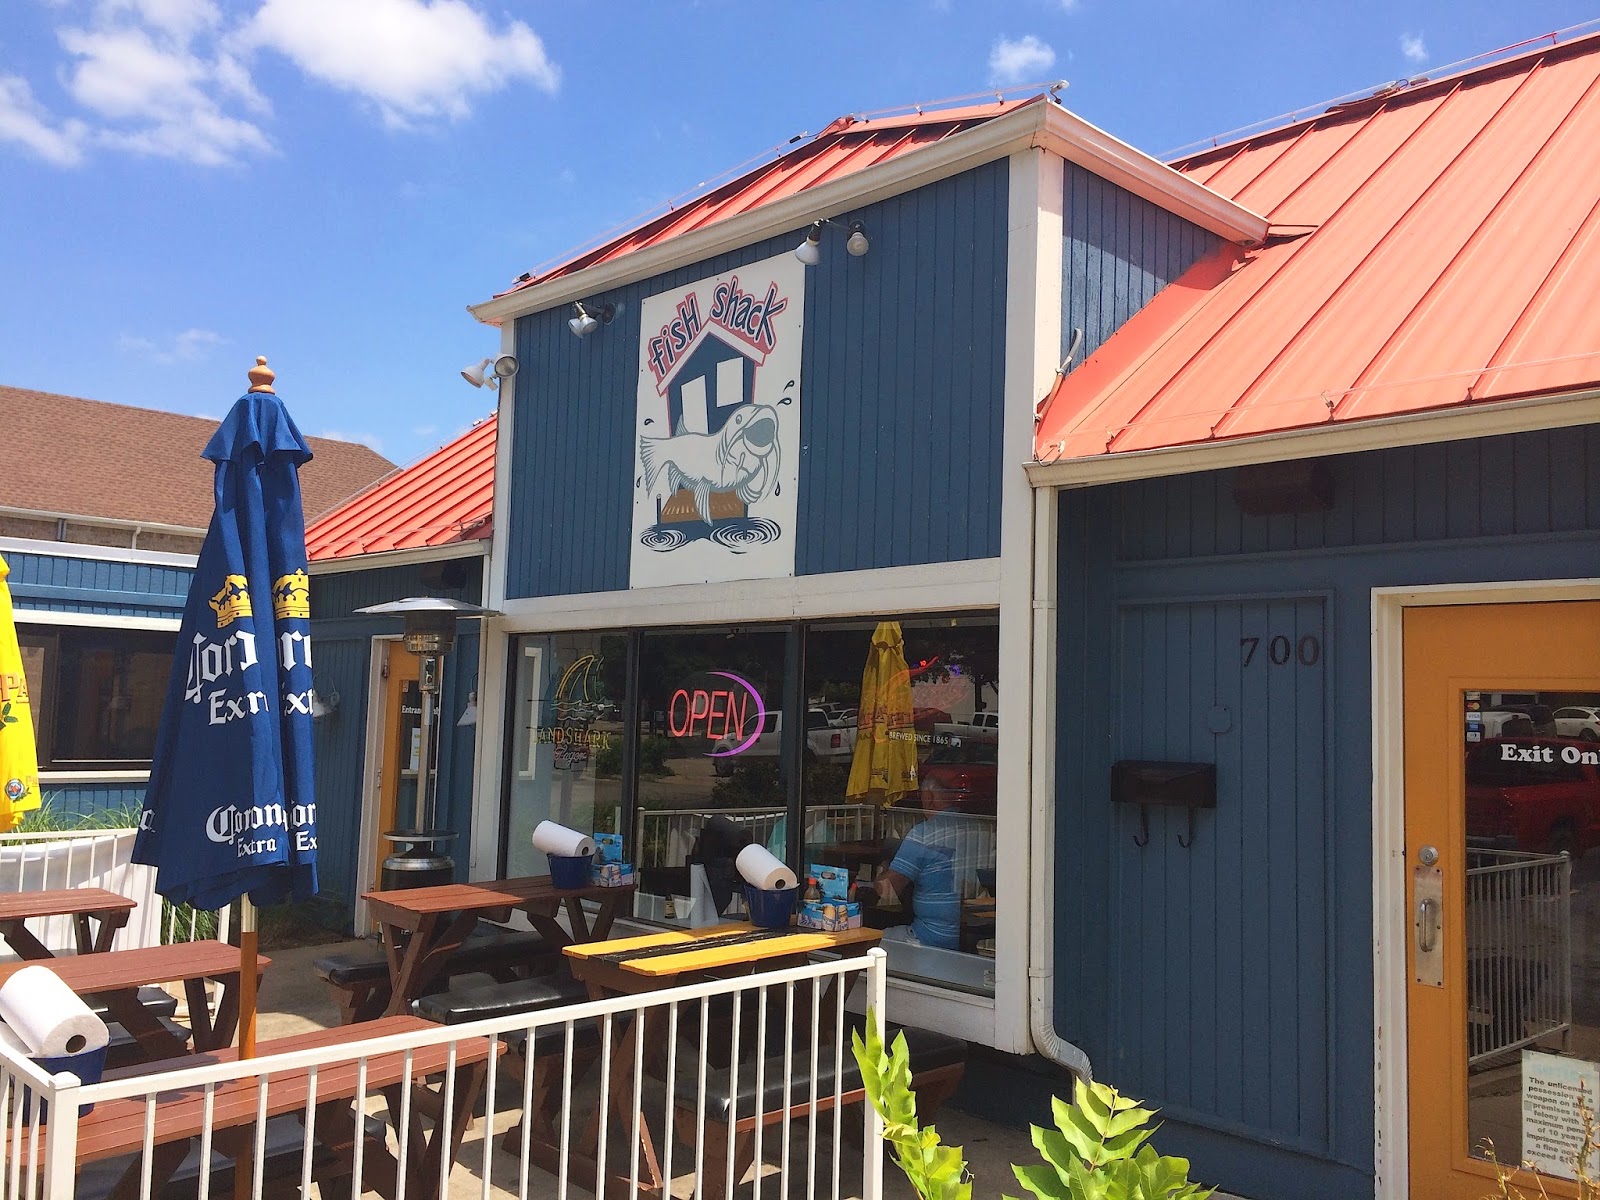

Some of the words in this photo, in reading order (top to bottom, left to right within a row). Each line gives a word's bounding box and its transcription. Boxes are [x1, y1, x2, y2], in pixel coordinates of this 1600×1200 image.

[1240, 635, 1320, 668] 700
[669, 689, 748, 741] OPEN
[888, 731, 913, 741] BREWED
[913, 733, 931, 743] SINCE
[932, 735, 949, 745] 1865
[1500, 743, 1554, 762] Exit
[1560, 746, 1600, 765] On
[205, 802, 288, 845] Coron
[237, 835, 277, 858] Extra
[1528, 1076, 1545, 1085] The
[1547, 1082, 1593, 1095] unlicensed
[1526, 1093, 1558, 1105] weapon
[1559, 1099, 1570, 1107] on
[1528, 1086, 1574, 1100] possession
[1532, 1102, 1571, 1115] premises
[1526, 1117, 1564, 1130] maximum
[1533, 1110, 1559, 1122] felony
[1561, 1115, 1580, 1125] with
[1548, 1129, 1559, 1137] 10
[1561, 1132, 1584, 1143] years
[1526, 1149, 1557, 1161] exceed
[1543, 1143, 1559, 1153] fine
